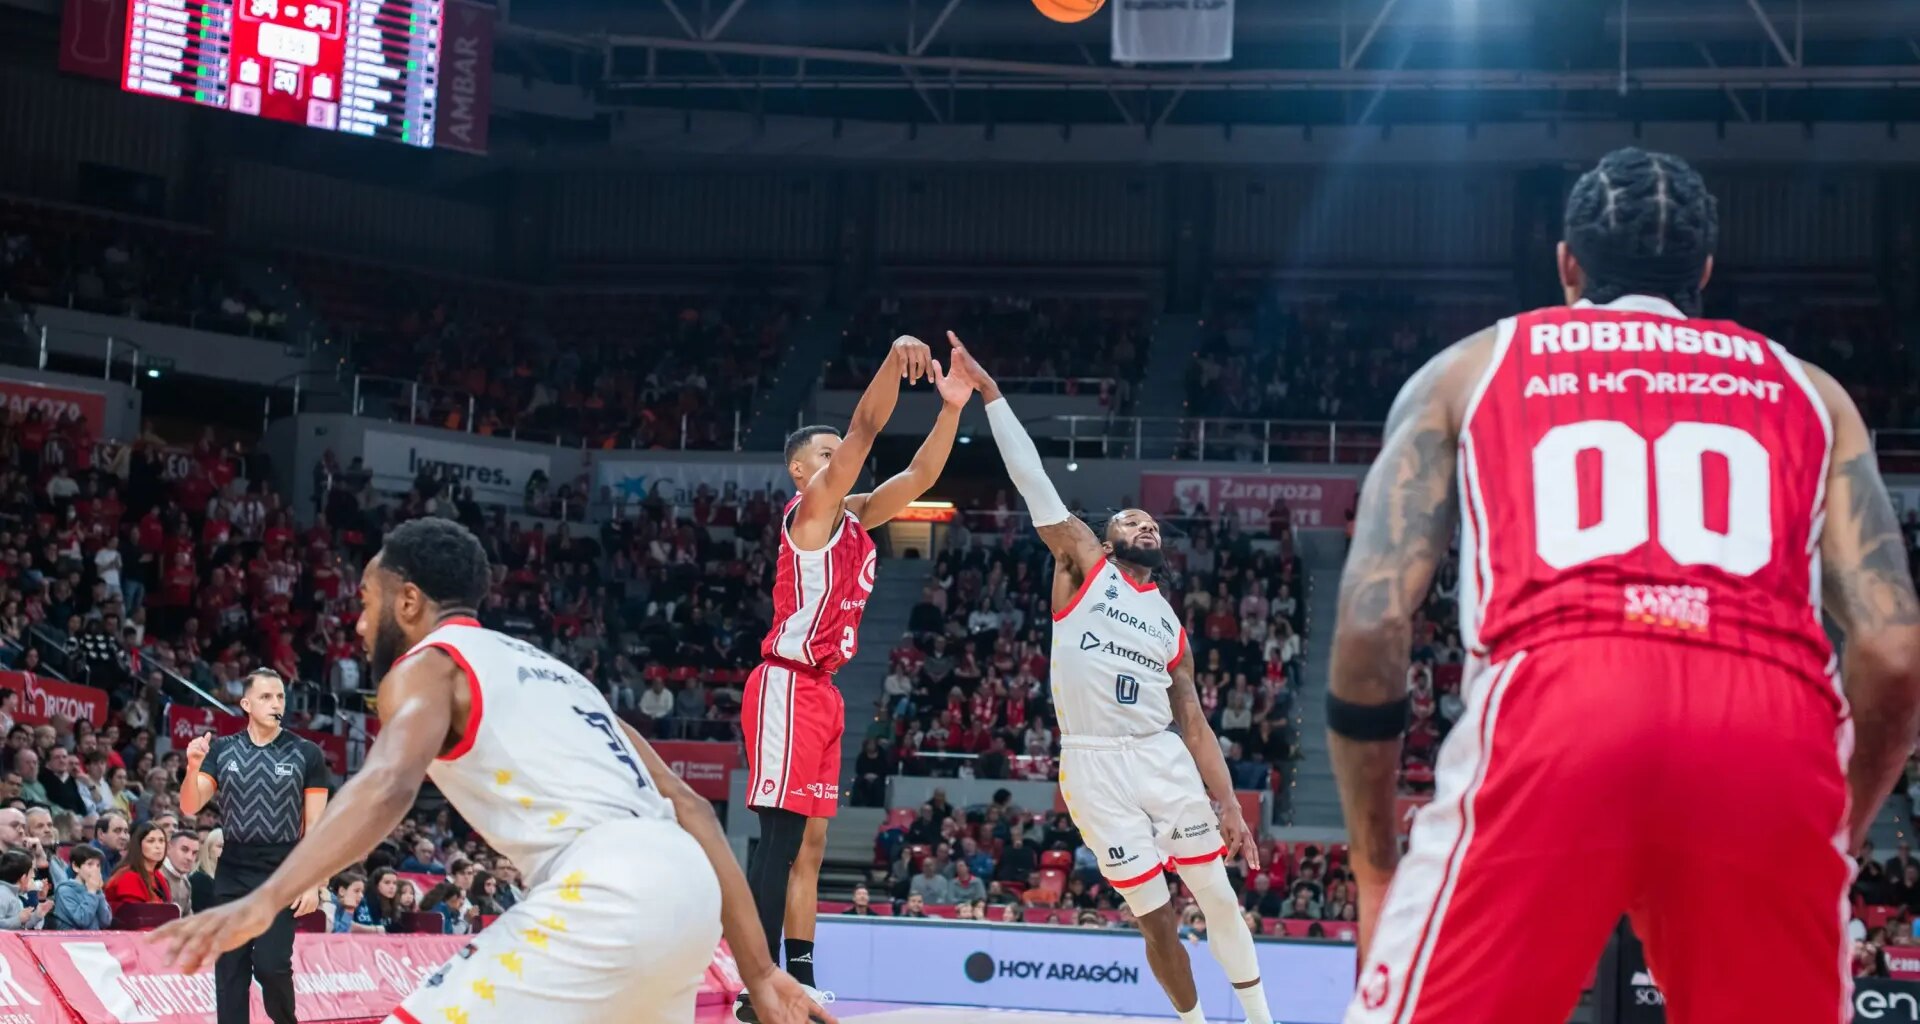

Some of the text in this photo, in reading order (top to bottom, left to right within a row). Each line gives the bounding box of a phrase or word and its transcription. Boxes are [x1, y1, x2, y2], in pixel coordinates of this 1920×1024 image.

[448, 36, 479, 143] AMBAR
[1530, 321, 1765, 365] ROBINSON
[1524, 368, 1784, 403] AIR HORIZONT
[1220, 478, 1323, 507] Zaragoza
[1532, 420, 1773, 577] 00
[1101, 641, 1165, 673] Andorra
[1116, 674, 1139, 705] 0
[999, 960, 1139, 984] HOY ARAGÓN
